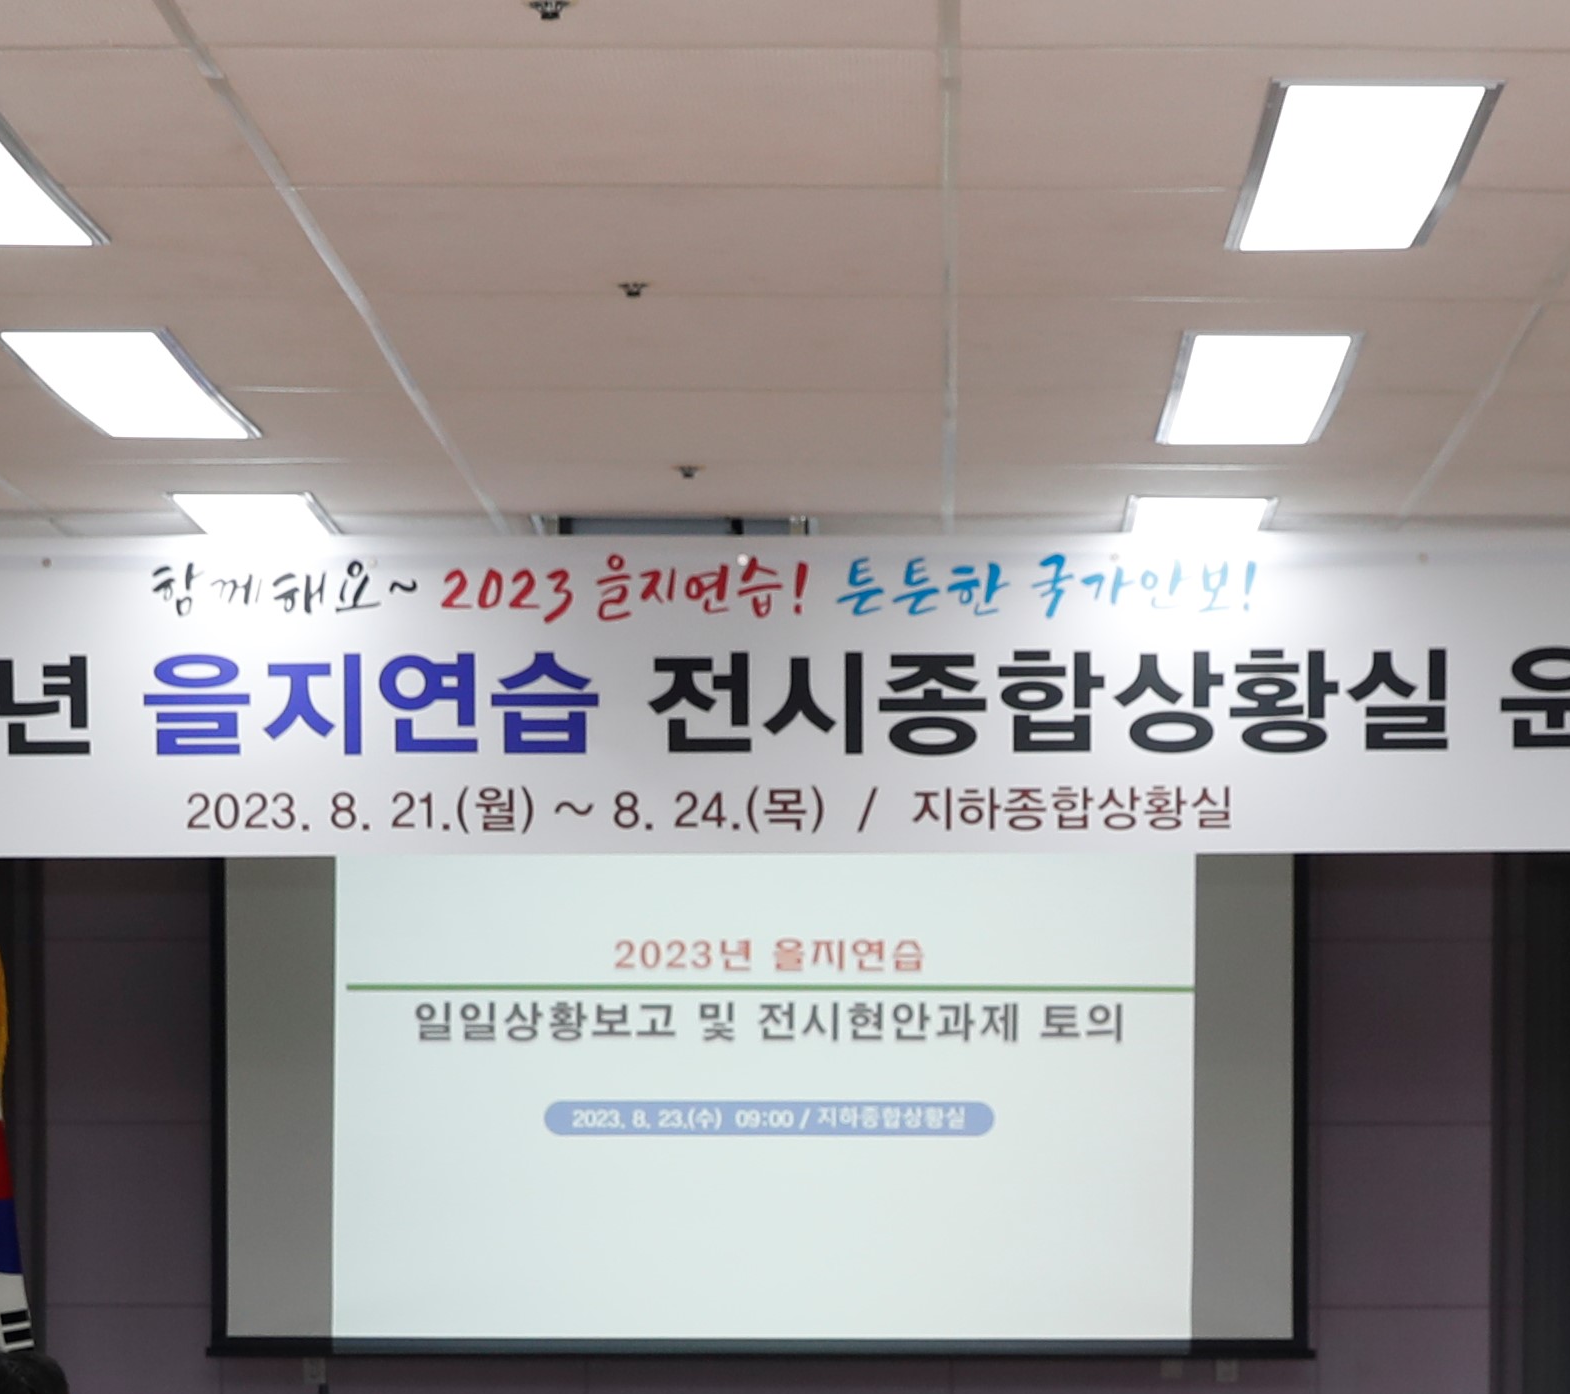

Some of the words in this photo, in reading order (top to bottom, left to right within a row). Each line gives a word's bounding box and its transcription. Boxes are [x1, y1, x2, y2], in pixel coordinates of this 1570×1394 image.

[440, 567, 575, 624] 2023
[595, 553, 810, 622] 을지연습!
[836, 556, 1010, 618] 튼튼한
[1030, 553, 1258, 620] 국가안보!
[143, 652, 600, 756] 을지연습
[648, 647, 1449, 756] 전시종합상황실
[186, 792, 310, 832] 2023.
[330, 791, 371, 832] 8.
[391, 785, 535, 835] 21.(월)
[613, 790, 654, 831] 8.
[674, 785, 825, 834] 24.(목)
[858, 786, 879, 833] /
[911, 785, 1232, 832] 지하종합상황실
[614, 939, 752, 972] 2023년
[774, 938, 924, 972] 을지연습
[414, 1000, 677, 1043] 일일상황보고
[698, 1001, 735, 1043] 및
[758, 1001, 1019, 1043] 전시현안과제
[1040, 1002, 1124, 1044] 토의
[572, 1109, 625, 1129] 2023.
[632, 1109, 651, 1129] 8.
[734, 1109, 795, 1128] 09:00
[799, 1108, 811, 1129] /
[819, 1105, 966, 1129] 지하종합상황실
